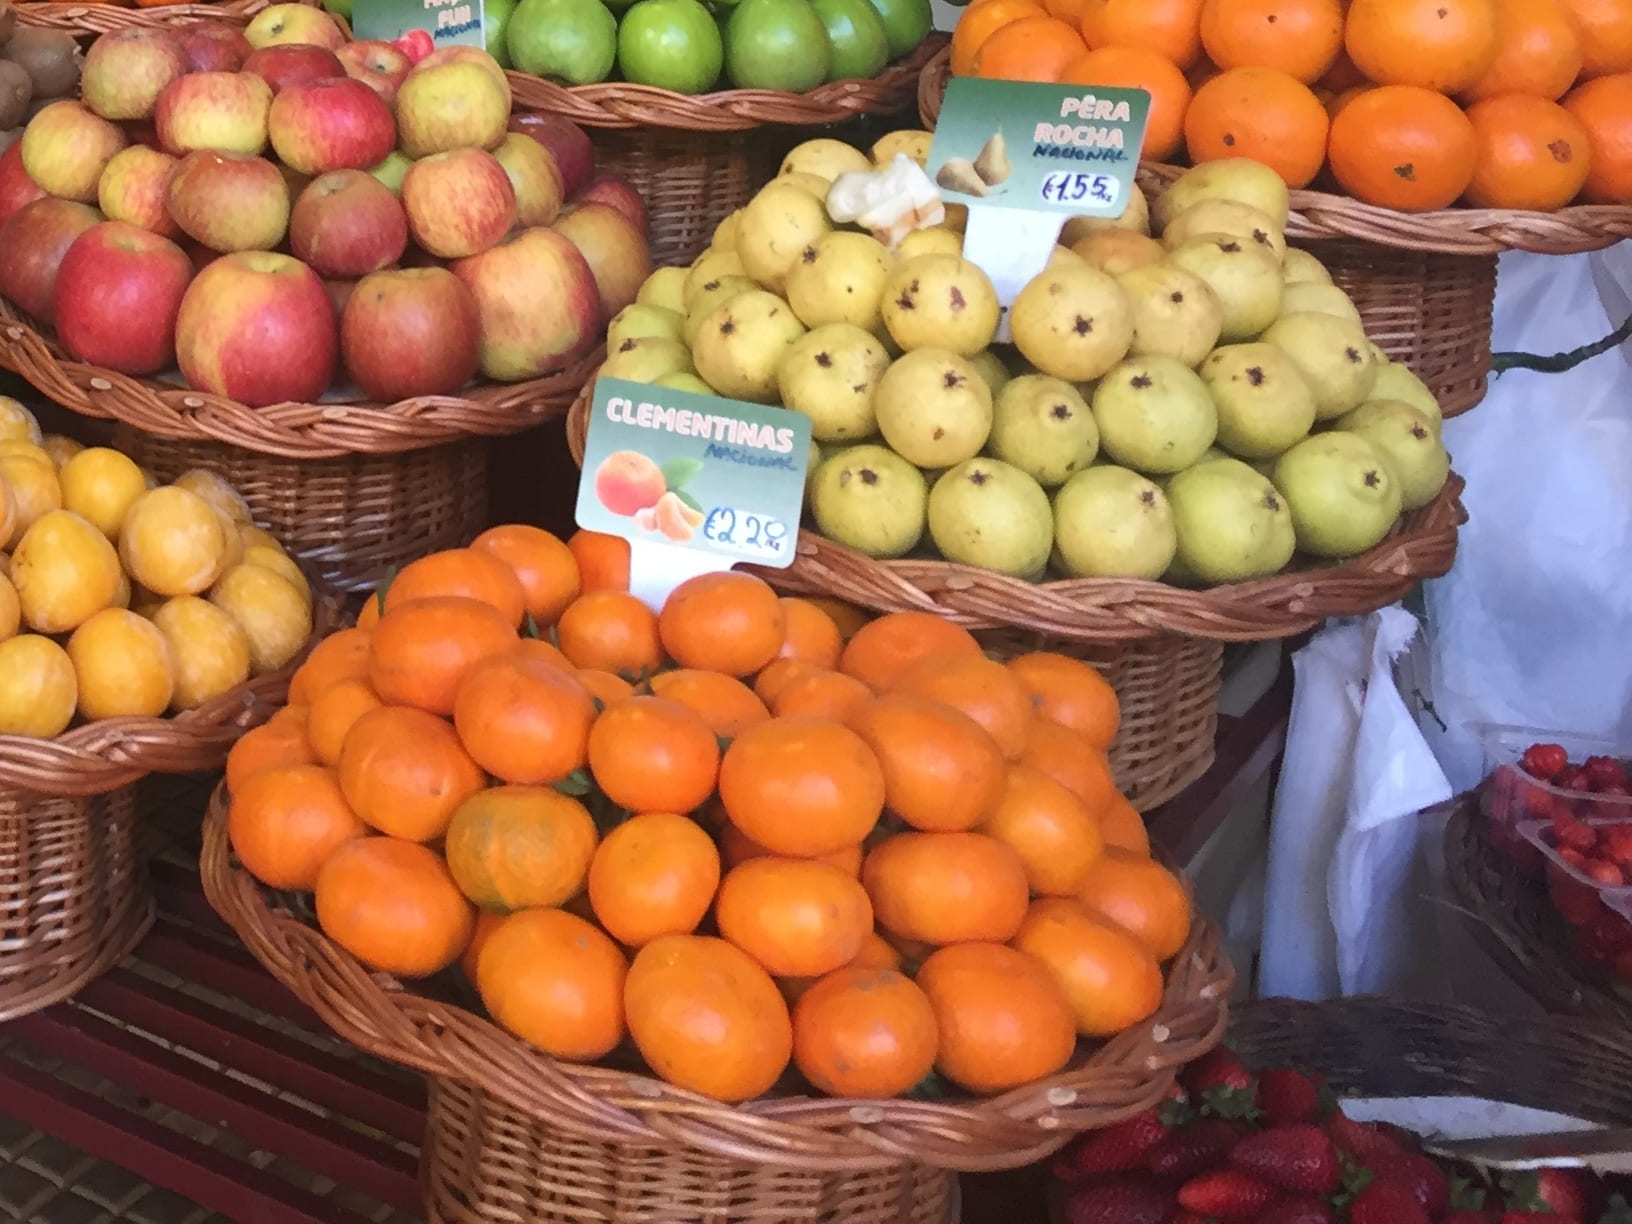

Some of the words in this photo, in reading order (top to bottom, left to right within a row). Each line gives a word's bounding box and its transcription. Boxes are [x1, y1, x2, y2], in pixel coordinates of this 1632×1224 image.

[1060, 94, 1131, 122] PÊRA
[1033, 123, 1124, 148] ROCHA
[606, 397, 795, 454] CLEMENTINAS
